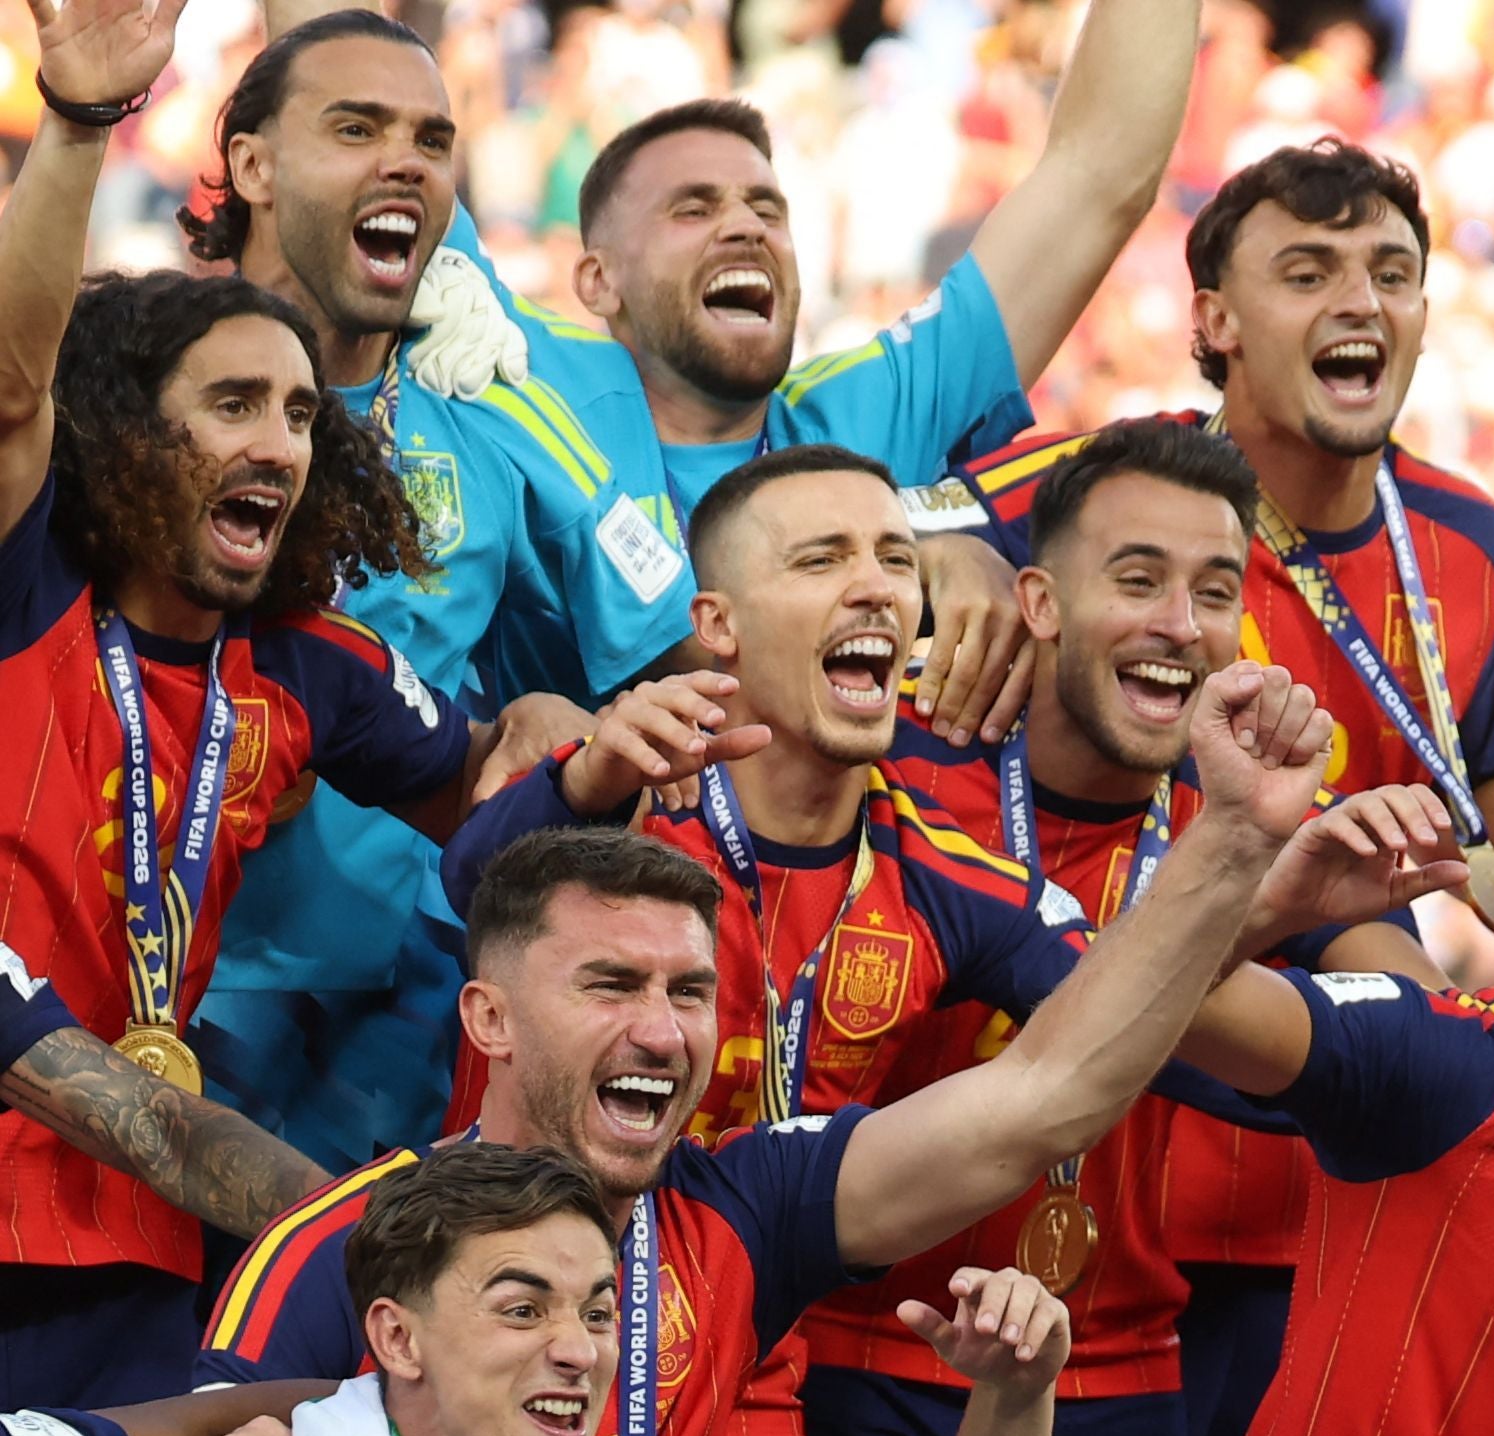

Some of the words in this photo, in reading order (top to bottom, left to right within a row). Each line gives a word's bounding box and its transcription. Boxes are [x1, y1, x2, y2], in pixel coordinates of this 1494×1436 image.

[107, 645, 132, 690] FIFA
[122, 690, 145, 765] WORLD
[209, 702, 229, 741] CUP
[1349, 637, 1379, 682] FIFA
[1374, 674, 1422, 740] WORLD
[1417, 736, 1447, 776] CUP
[1441, 771, 1482, 836] 2026
[131, 766, 147, 812] CUP
[192, 740, 222, 815] WORLD
[1008, 757, 1024, 802] FIFA
[132, 809, 151, 885] 2026
[184, 815, 208, 861] FIFA
[723, 832, 750, 871] FIFA
[1011, 802, 1032, 863] WORL
[785, 997, 806, 1064] 2026
[631, 1263, 649, 1307] CUP
[629, 1311, 649, 1388] WORLD
[628, 1389, 648, 1435] FIFA
